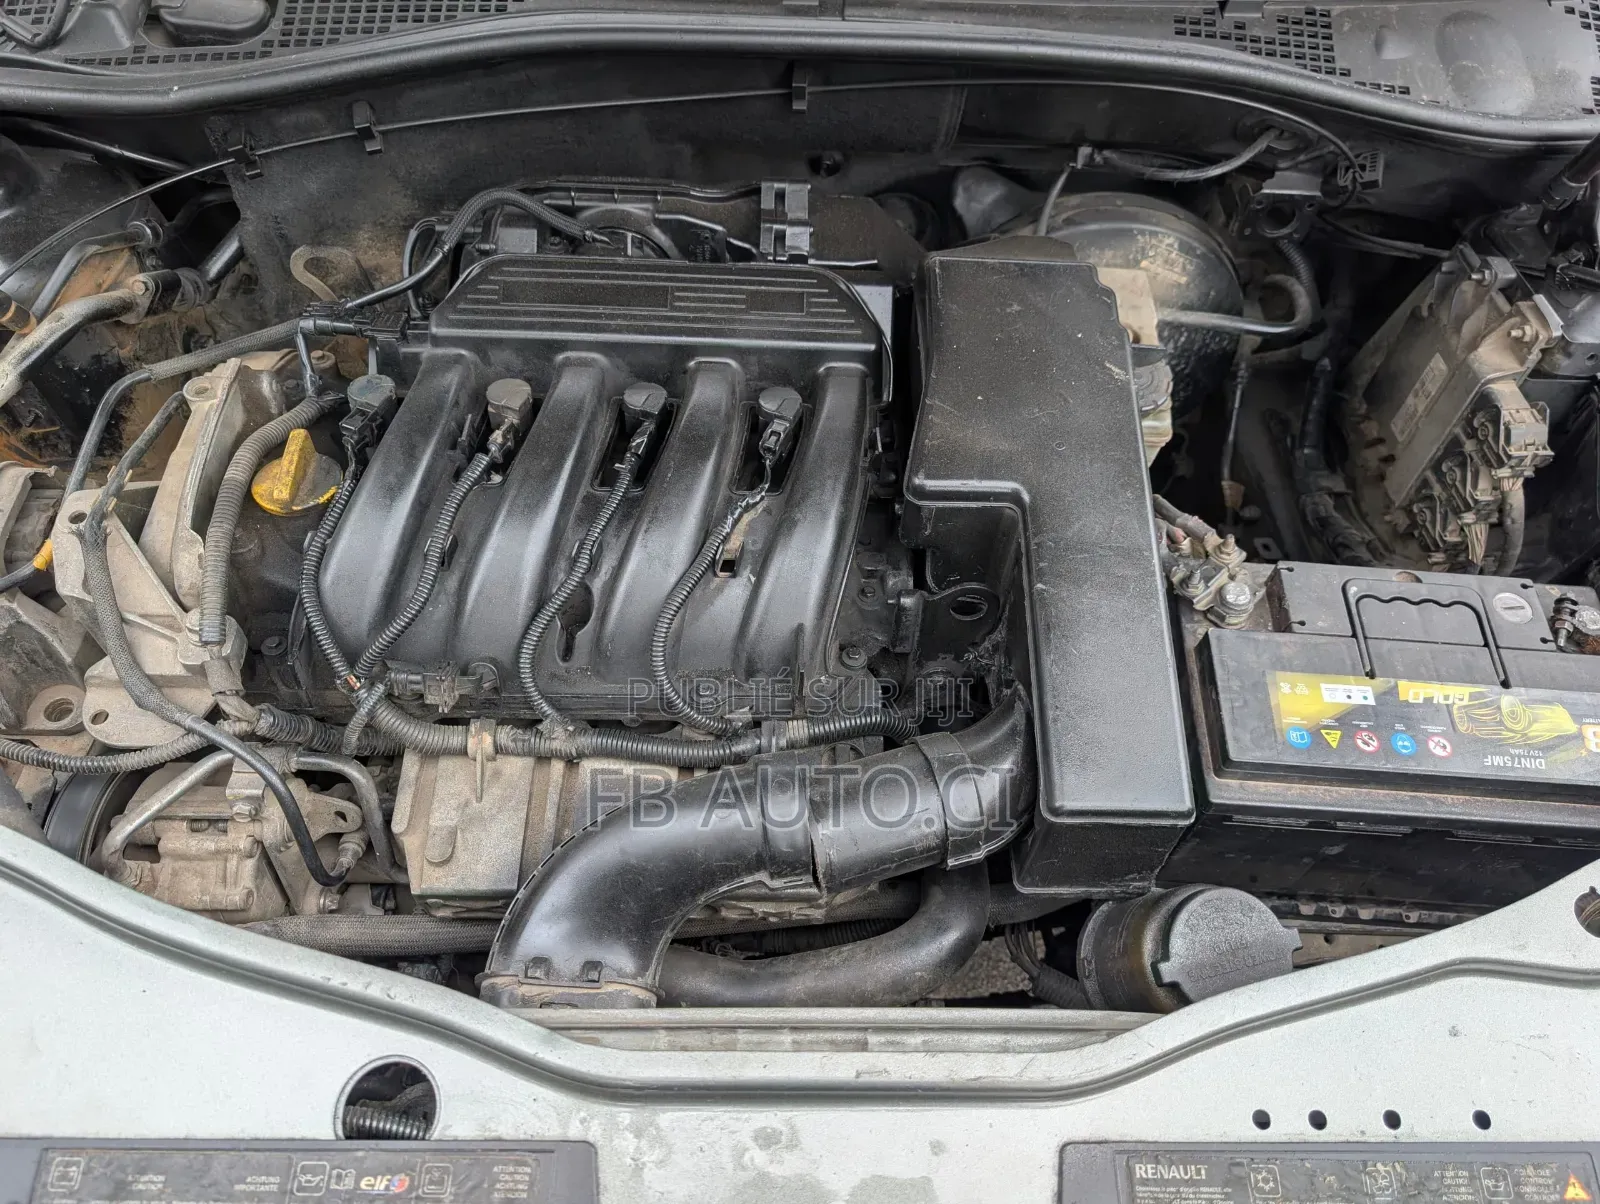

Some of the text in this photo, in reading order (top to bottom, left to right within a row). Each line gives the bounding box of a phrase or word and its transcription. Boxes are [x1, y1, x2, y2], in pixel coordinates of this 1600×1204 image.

[1409, 688, 1470, 704] GOLD
[1483, 754, 1546, 770] DIN75MF
[1134, 1163, 1208, 1180] RENAULT
[359, 1174, 392, 1191] elf
